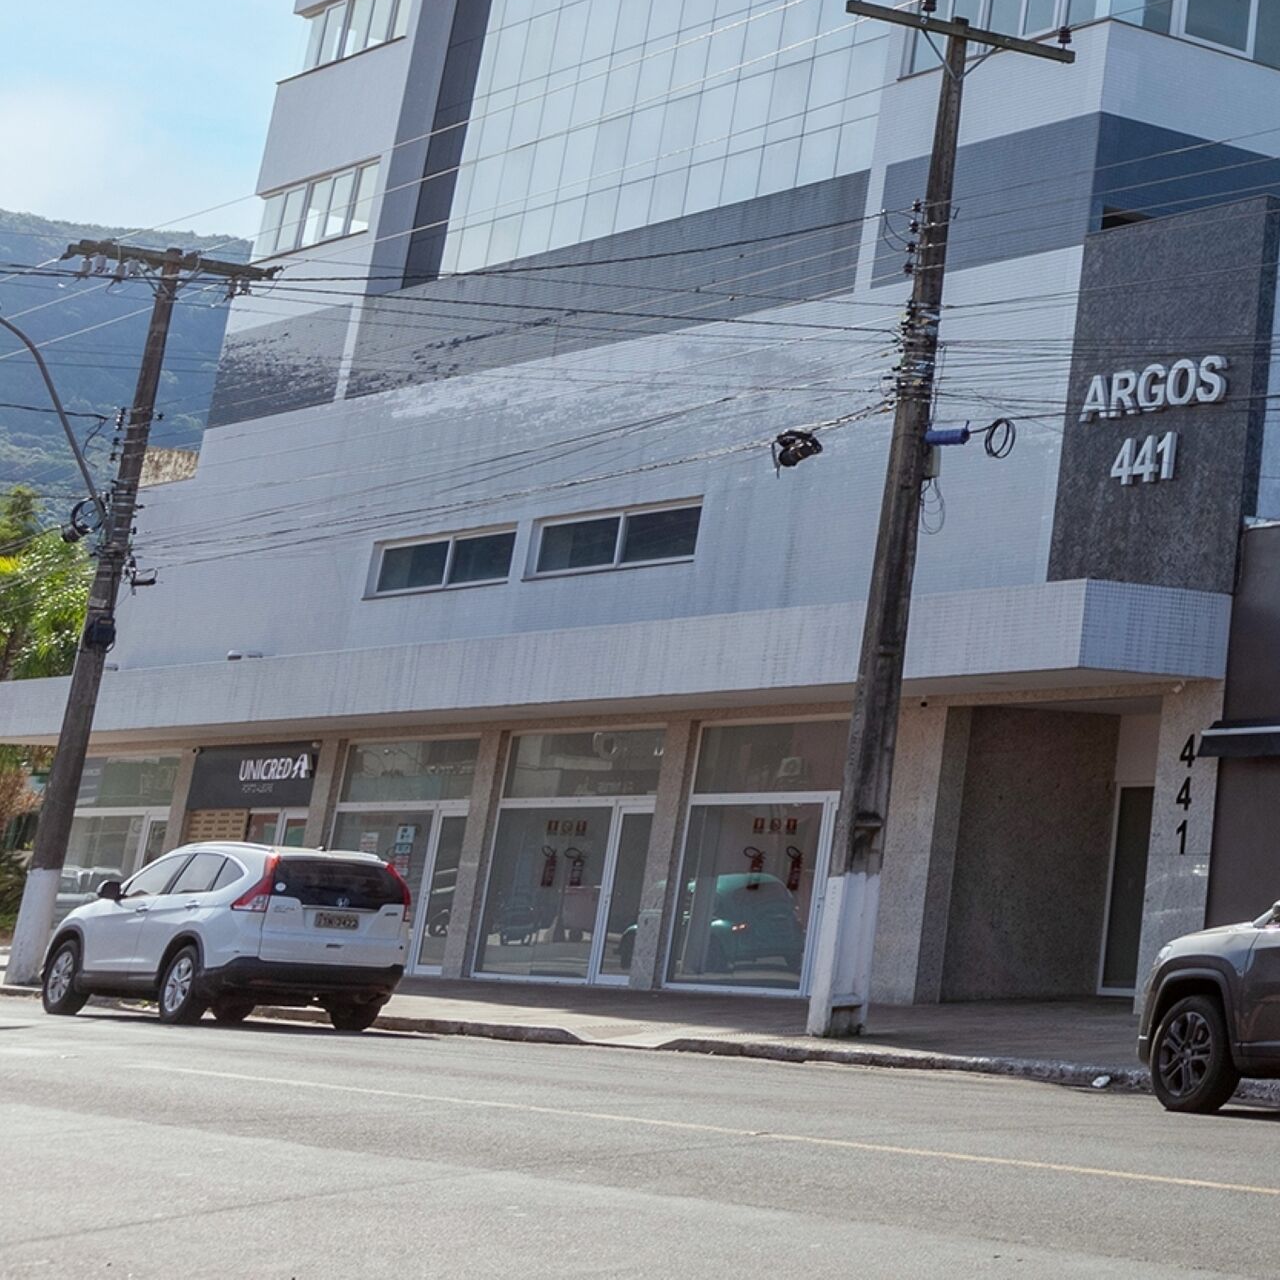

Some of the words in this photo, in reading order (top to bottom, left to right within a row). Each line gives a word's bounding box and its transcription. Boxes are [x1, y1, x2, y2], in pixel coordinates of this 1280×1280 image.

[1079, 355, 1228, 422] ARGOS
[1111, 431, 1178, 485] 441
[239, 757, 292, 781] UNICRED
[1176, 733, 1196, 855] 441
